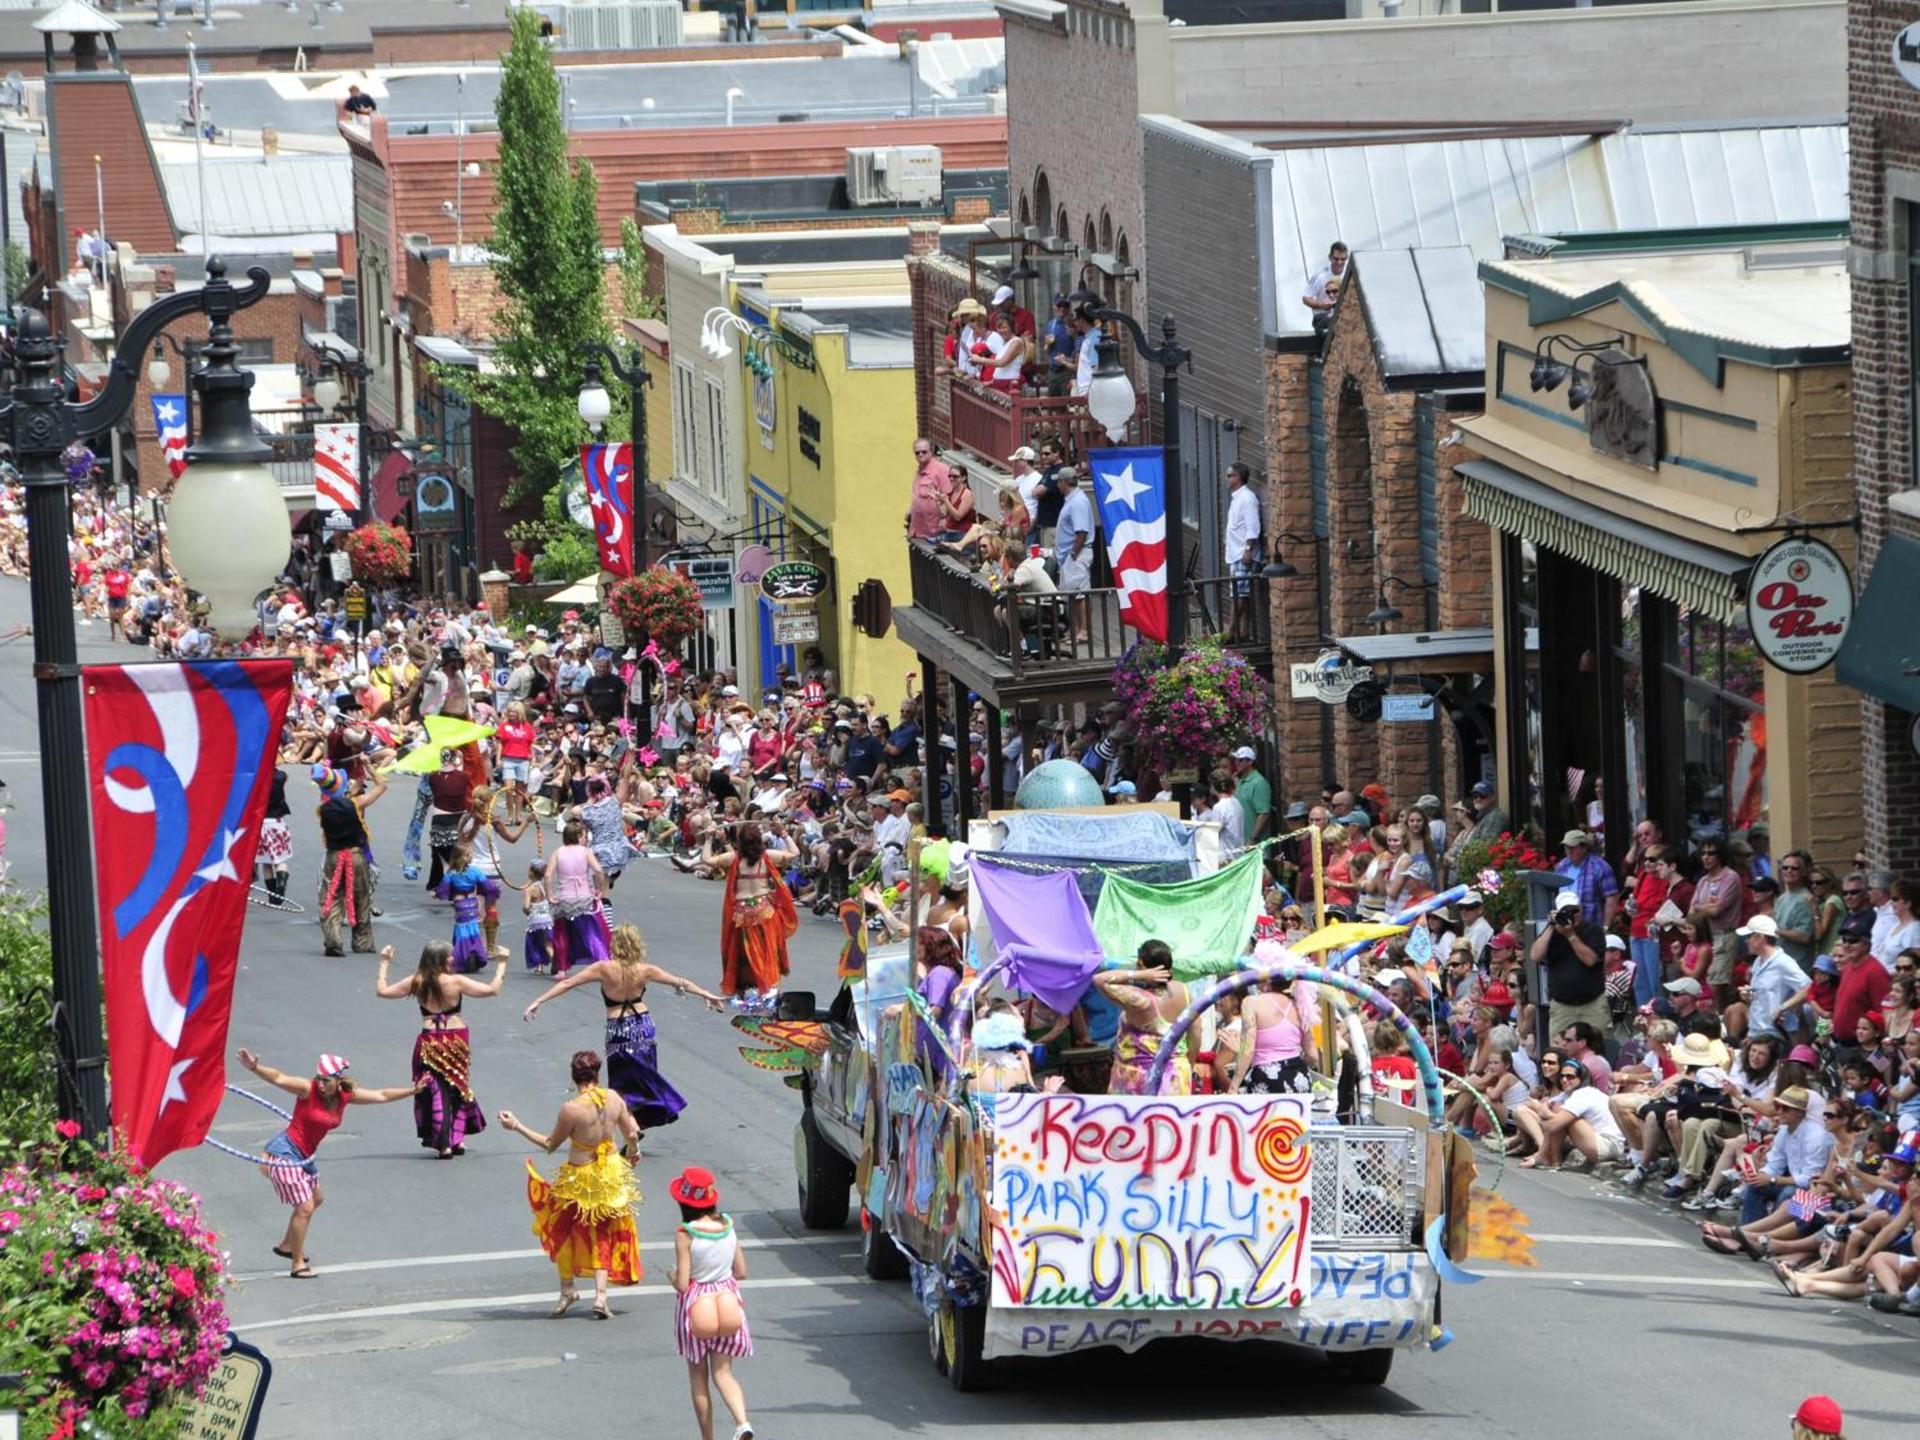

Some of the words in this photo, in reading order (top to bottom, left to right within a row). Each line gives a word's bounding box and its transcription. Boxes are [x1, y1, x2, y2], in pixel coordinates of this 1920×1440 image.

[765, 564, 793, 584] JAVA
[1772, 647, 1834, 657] CONVENIENCE
[1781, 641, 1824, 650] OUTDOOR
[1789, 654, 1818, 662] STORE
[1000, 1170, 1108, 1228] PARK
[1021, 1319, 1151, 1352] PEACE
[1298, 1319, 1414, 1346] LIFE!
[222, 1365, 238, 1380] TO
[204, 1378, 227, 1393] ARK
[203, 1391, 242, 1415] BLOCK
